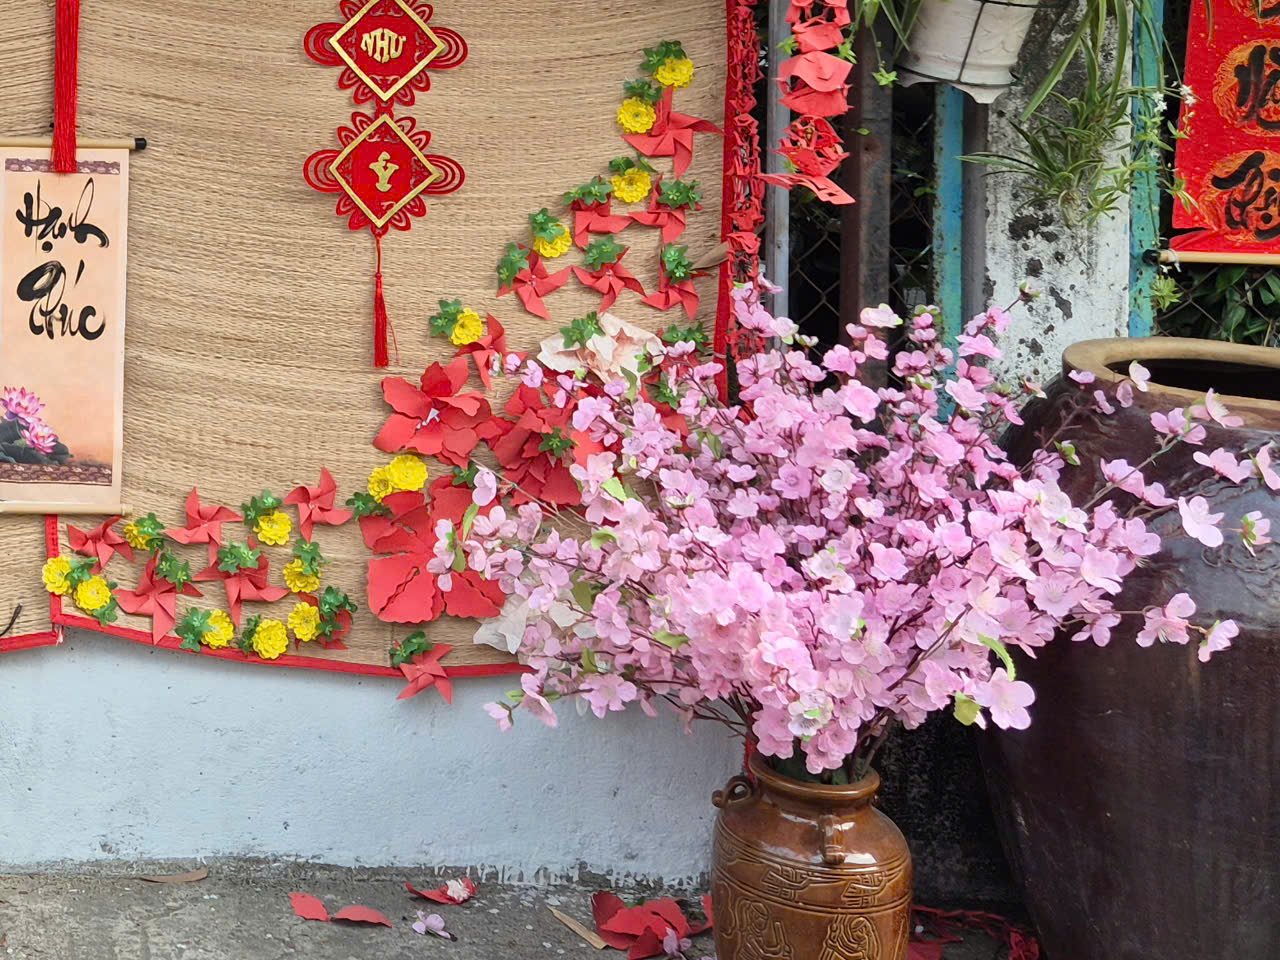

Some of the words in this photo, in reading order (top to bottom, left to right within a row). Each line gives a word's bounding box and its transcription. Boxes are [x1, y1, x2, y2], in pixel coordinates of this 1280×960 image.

[361, 27, 407, 64] NHƯ
[16, 178, 110, 253] Hạnh
[17, 260, 106, 340] Phúc
